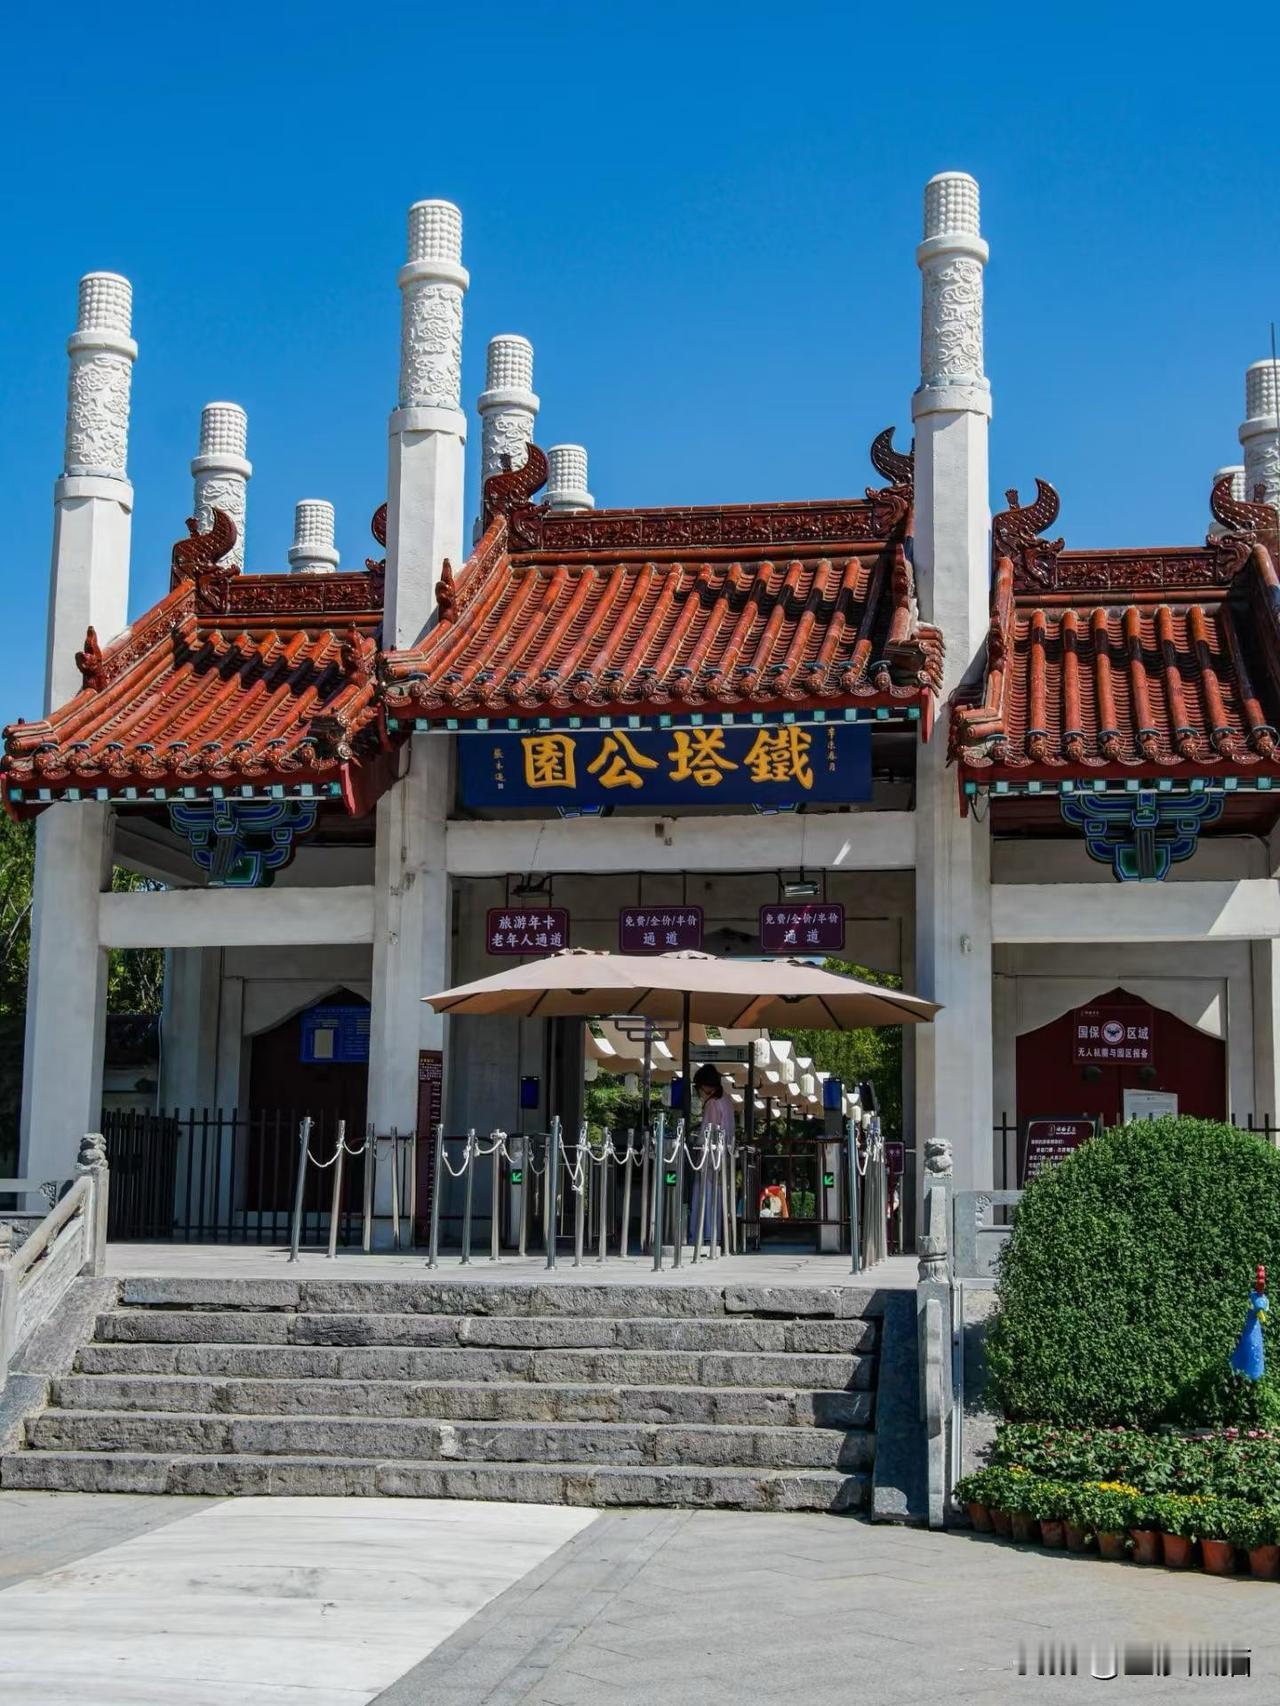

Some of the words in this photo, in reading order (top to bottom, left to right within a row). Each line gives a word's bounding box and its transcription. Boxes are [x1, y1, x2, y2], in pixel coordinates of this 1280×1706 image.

[499, 914, 555, 930] 旅游年卡
[625, 914, 697, 927] 免费/全价/半价
[766, 912, 838, 925] 免费/全价/半价
[491, 932, 562, 948] 老年人通道
[1078, 1025, 1100, 1039] 国保
[1127, 1026, 1149, 1040] 区域
